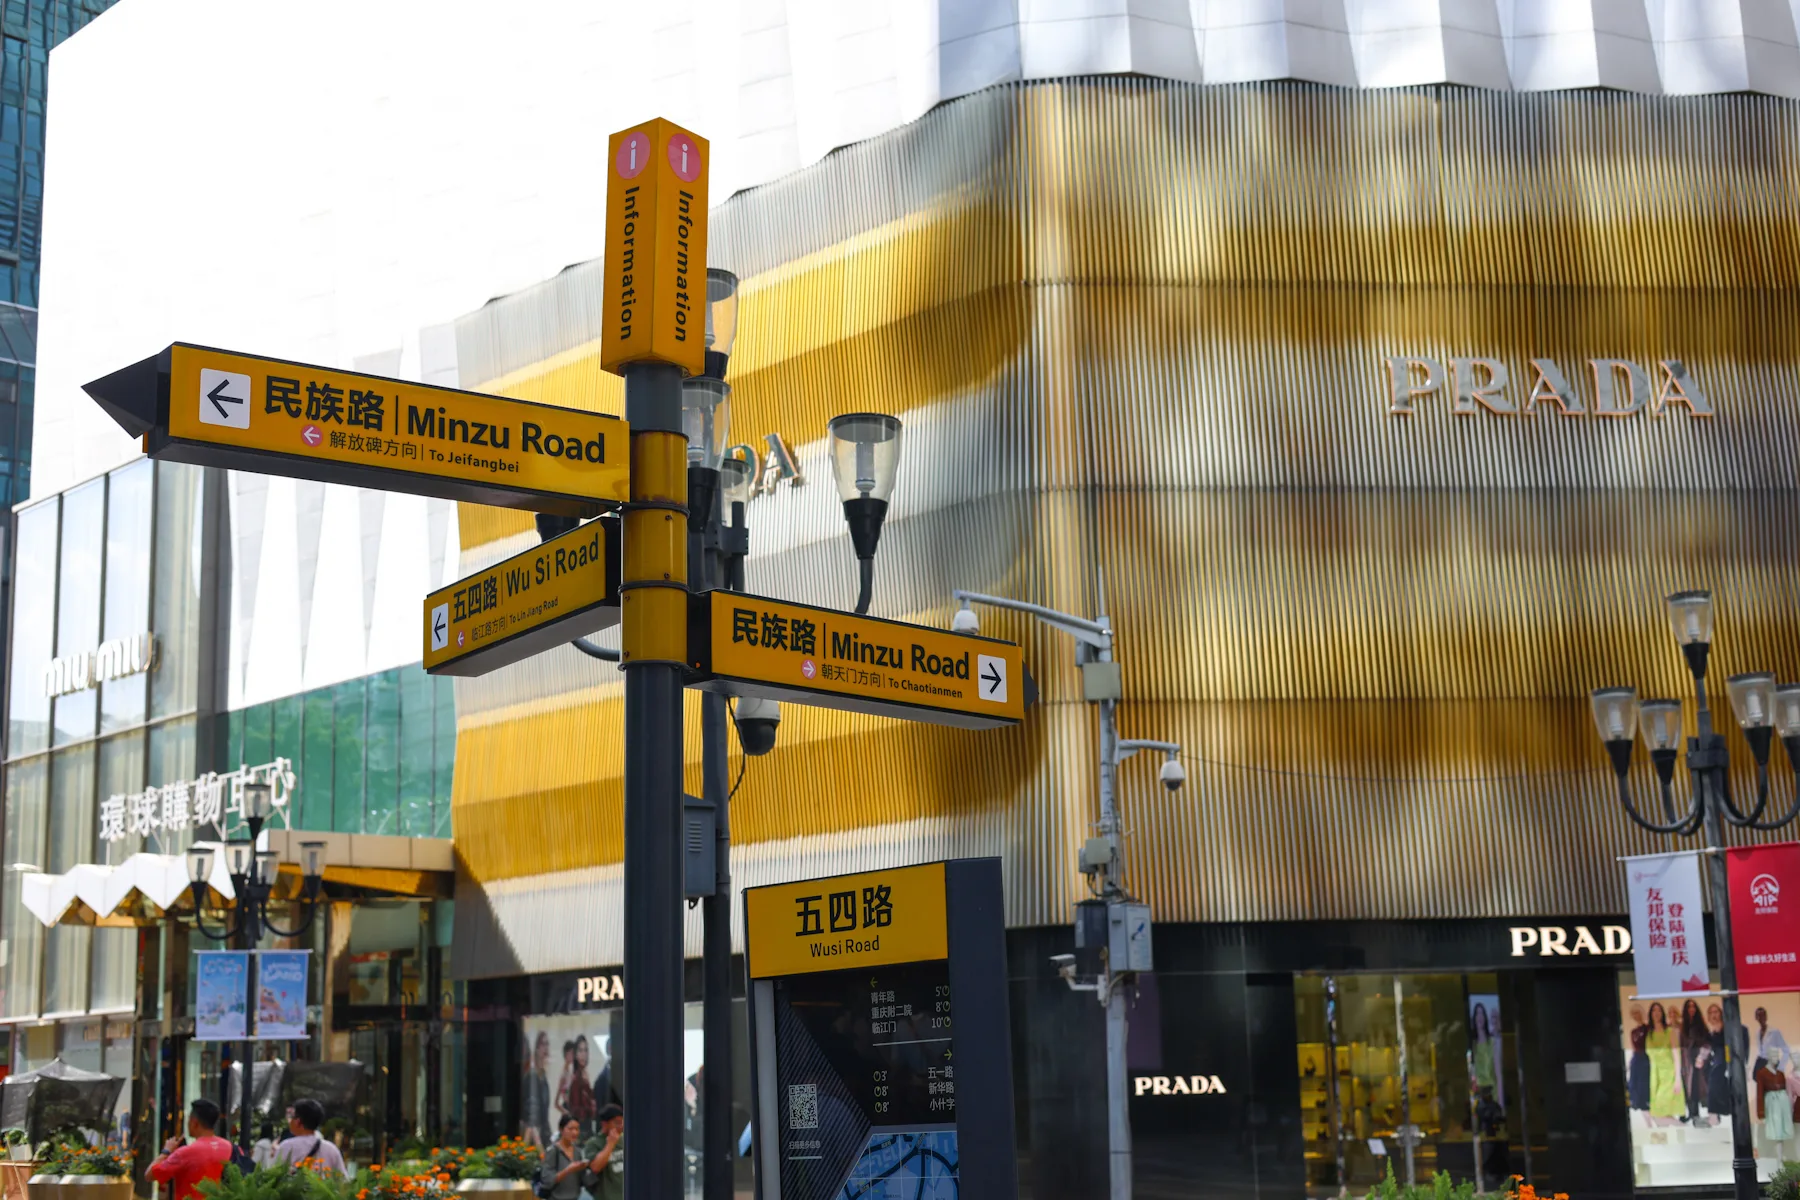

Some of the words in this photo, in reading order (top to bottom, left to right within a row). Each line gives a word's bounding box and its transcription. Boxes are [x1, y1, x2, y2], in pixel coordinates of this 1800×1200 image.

[620, 186, 640, 340] Information
[675, 190, 693, 342] Information
[1384, 356, 1714, 417] PRADA
[264, 375, 384, 432] 民族路
[408, 405, 509, 450] Minzu
[522, 422, 605, 464] Road
[329, 430, 417, 460] 解放碑方向
[429, 450, 444, 462] To
[447, 451, 519, 473] Jeifangbei
[453, 575, 498, 623] 五四路
[506, 567, 530, 597] Wu
[535, 554, 551, 585] Si
[556, 532, 598, 577] Road
[472, 616, 506, 642] 临江路方向
[509, 614, 517, 624] To
[517, 610, 526, 622] Lin
[526, 605, 542, 619] Jiang
[543, 597, 559, 611] Road
[732, 608, 816, 656] 民族路
[832, 631, 903, 669] Minzu
[911, 644, 970, 680] Road
[821, 664, 881, 688] 朝天门方向
[889, 677, 899, 689] To
[901, 679, 963, 699] Chaotianmen
[795, 884, 893, 936] 五四路
[1646, 887, 1667, 949] 友邦保险
[810, 940, 842, 957] Wusi
[845, 935, 879, 953] Road
[1508, 925, 1635, 956] PRAD
[1668, 903, 1689, 966] 登陆重庆
[577, 975, 624, 1003] PRA
[871, 990, 895, 1004] 青年路
[871, 1004, 912, 1019] 重庆附二院
[871, 1021, 897, 1034] 临江门
[928, 1066, 954, 1079] 五一路
[928, 1081, 955, 1095] 新华路
[1134, 1075, 1227, 1096] PRADA
[929, 1098, 956, 1111] 小什字
